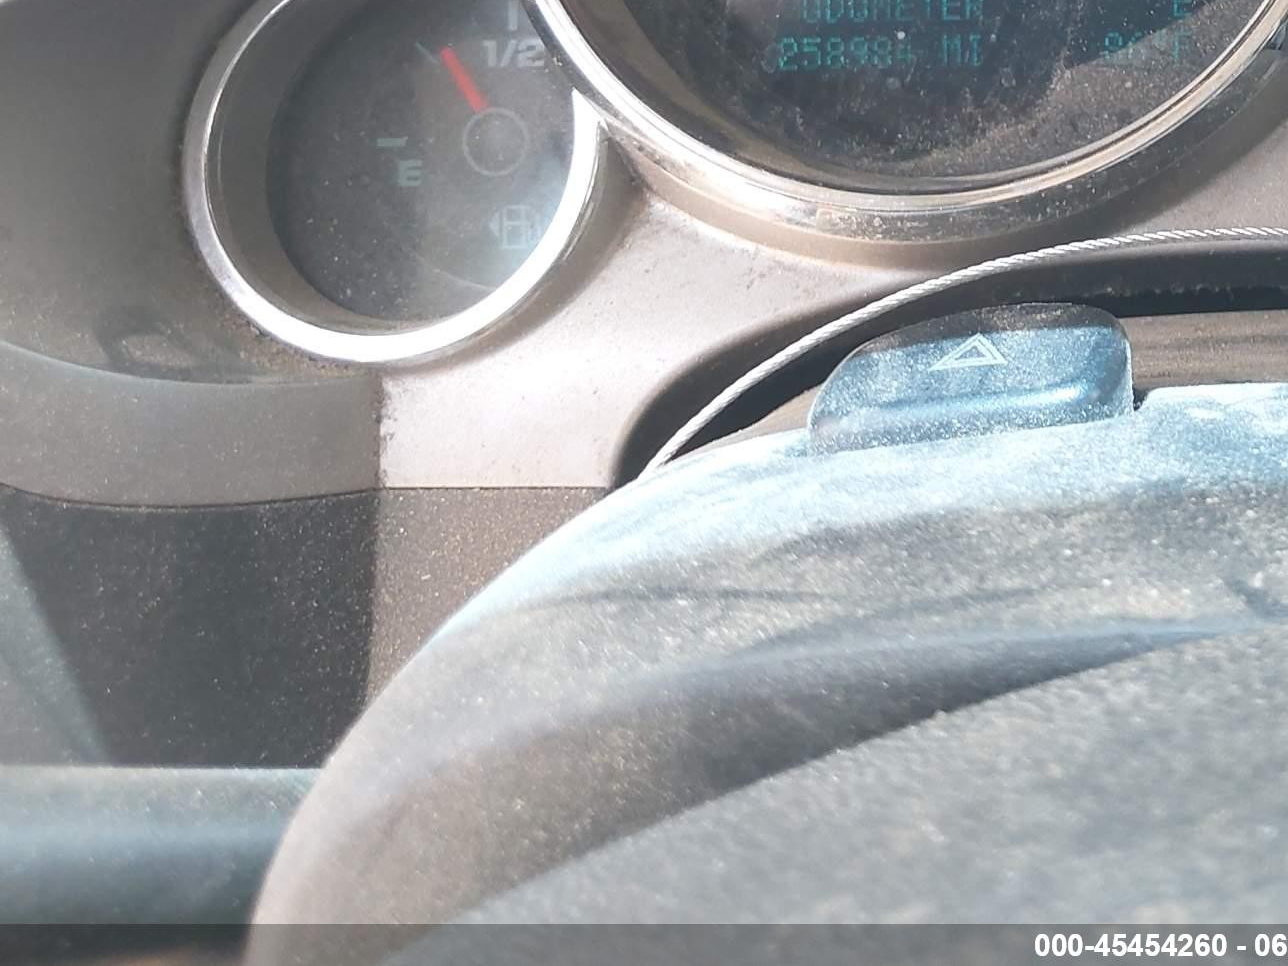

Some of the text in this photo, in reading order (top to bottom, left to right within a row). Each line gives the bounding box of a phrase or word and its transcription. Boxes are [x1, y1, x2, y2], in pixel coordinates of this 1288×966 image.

[480, 39, 546, 68] 1/2
[941, 33, 985, 68] MI
[396, 160, 423, 187] E
